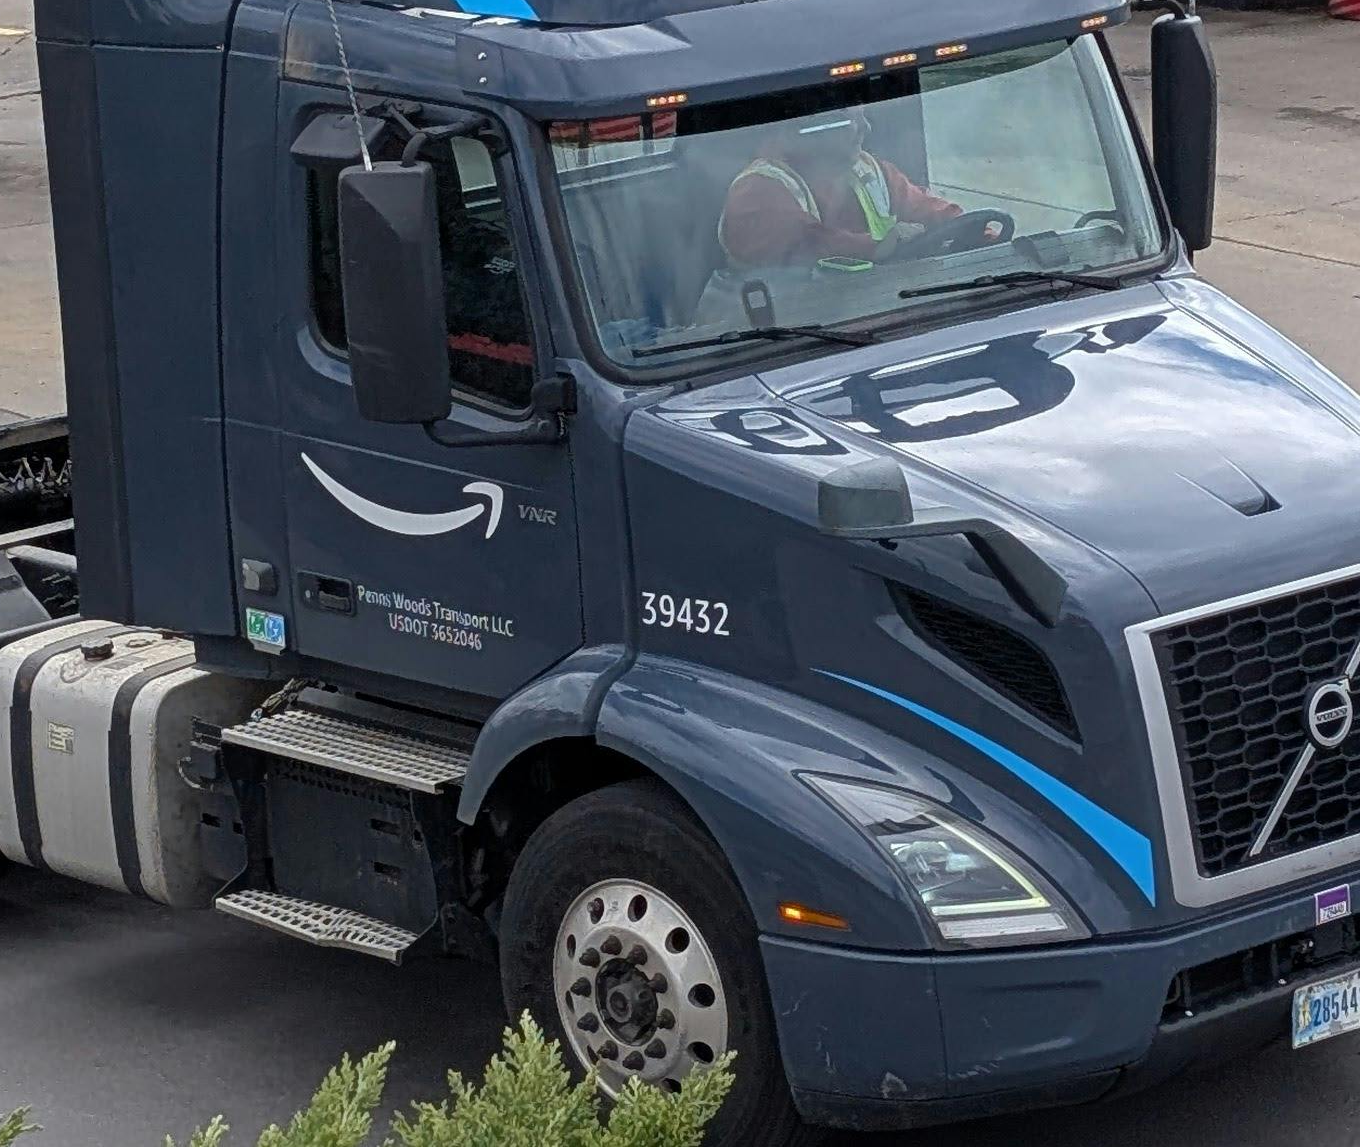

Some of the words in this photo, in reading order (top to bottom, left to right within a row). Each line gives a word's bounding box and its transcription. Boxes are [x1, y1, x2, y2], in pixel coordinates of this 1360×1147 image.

[518, 504, 557, 525] VNR
[357, 584, 391, 607] Penns
[392, 592, 432, 617] Woods
[433, 601, 489, 632] Transport
[492, 615, 514, 637] LLC
[388, 612, 429, 638] USDOT
[641, 591, 730, 636] 39432
